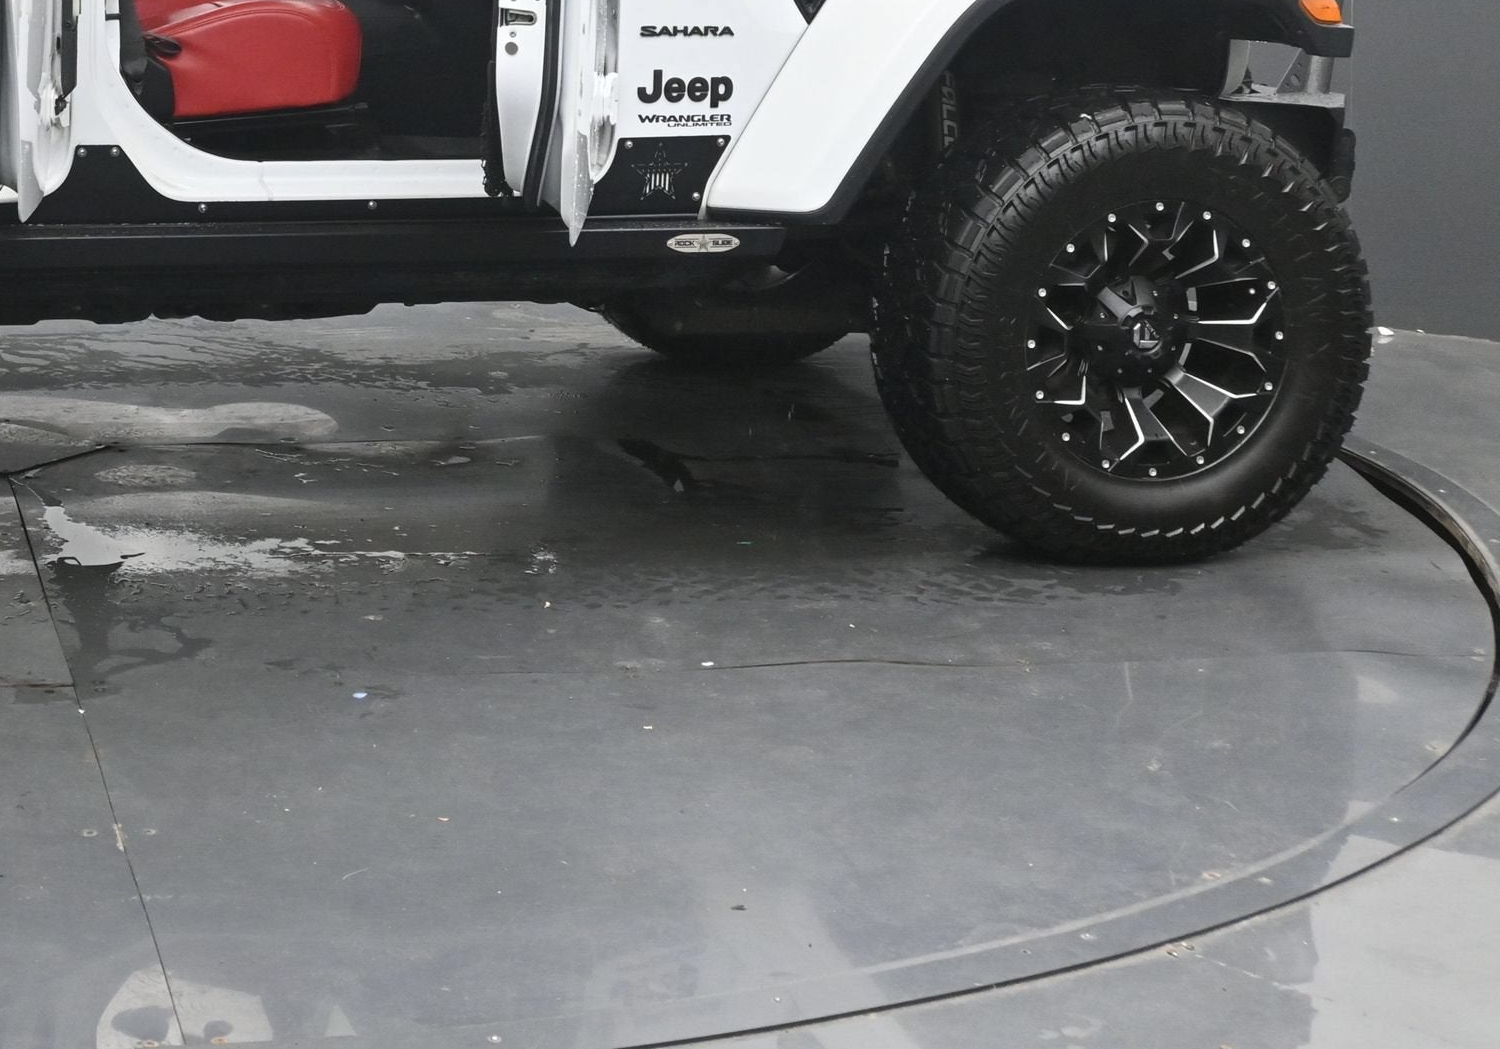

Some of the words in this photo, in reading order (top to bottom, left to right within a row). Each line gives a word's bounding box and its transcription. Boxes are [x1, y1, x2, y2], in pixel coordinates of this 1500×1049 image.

[639, 25, 735, 38] SAHARA
[637, 69, 733, 108] Jeep
[637, 113, 732, 124] WRANGLER
[666, 120, 732, 128] UNLIMITED
[674, 239, 697, 248] ROCK
